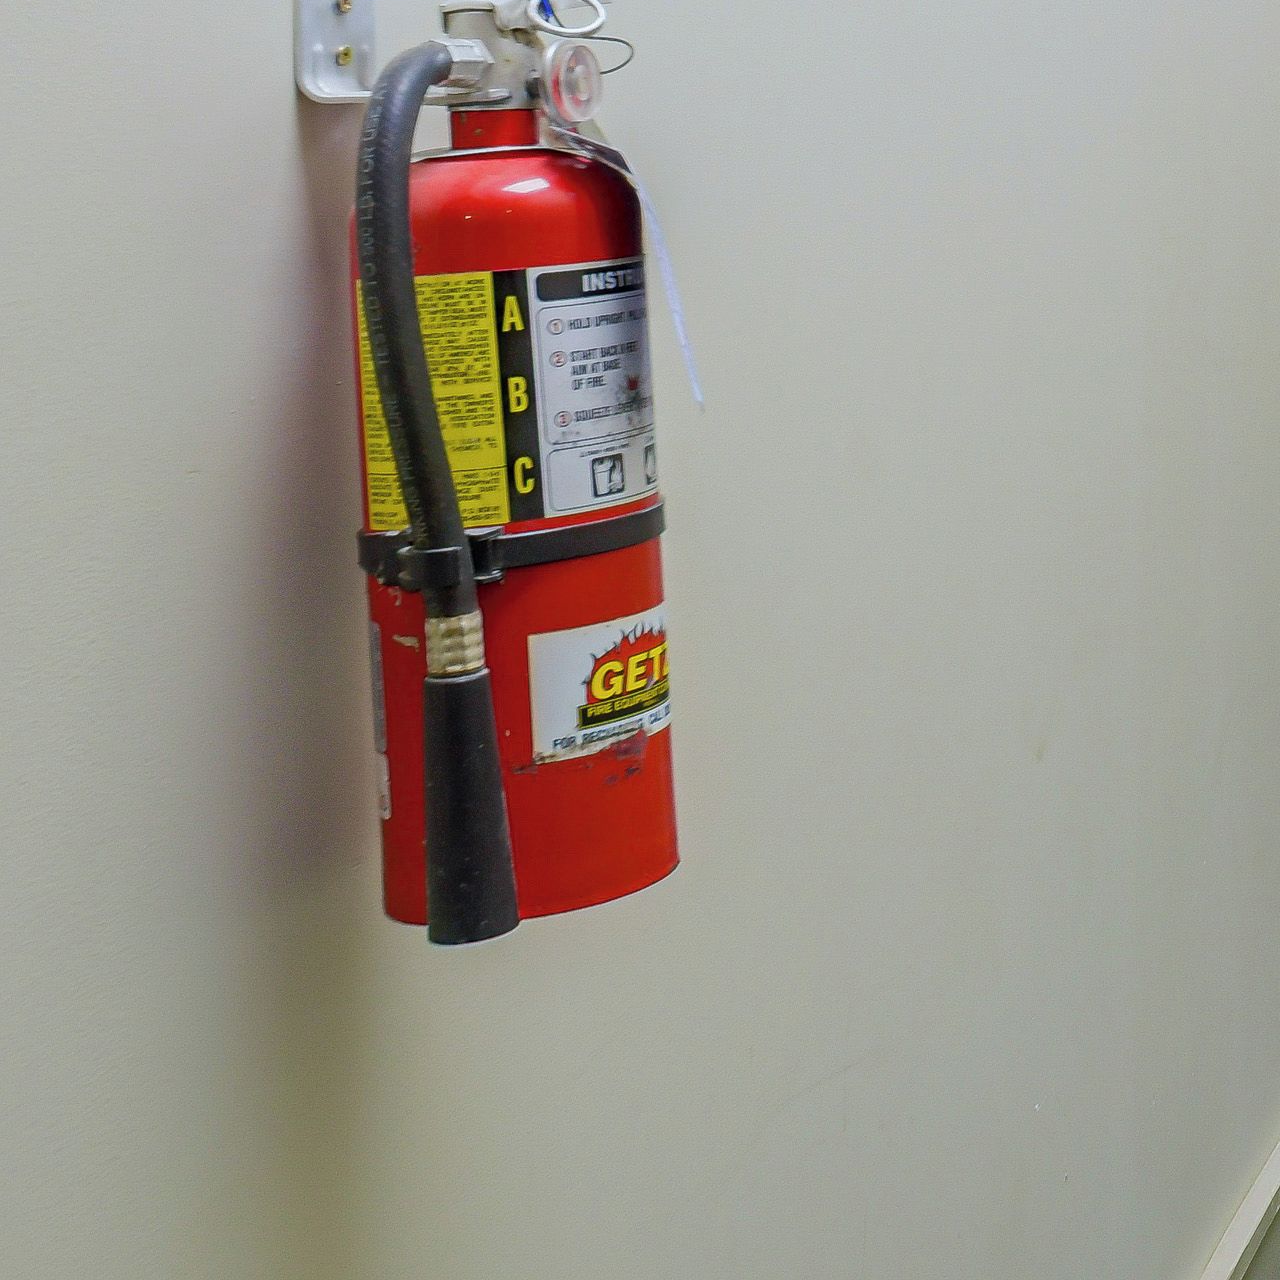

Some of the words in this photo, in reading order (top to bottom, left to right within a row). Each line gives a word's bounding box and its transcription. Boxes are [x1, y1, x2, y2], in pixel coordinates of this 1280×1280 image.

[502, 295, 525, 333] A
[507, 376, 529, 414] B
[513, 455, 536, 495] C
